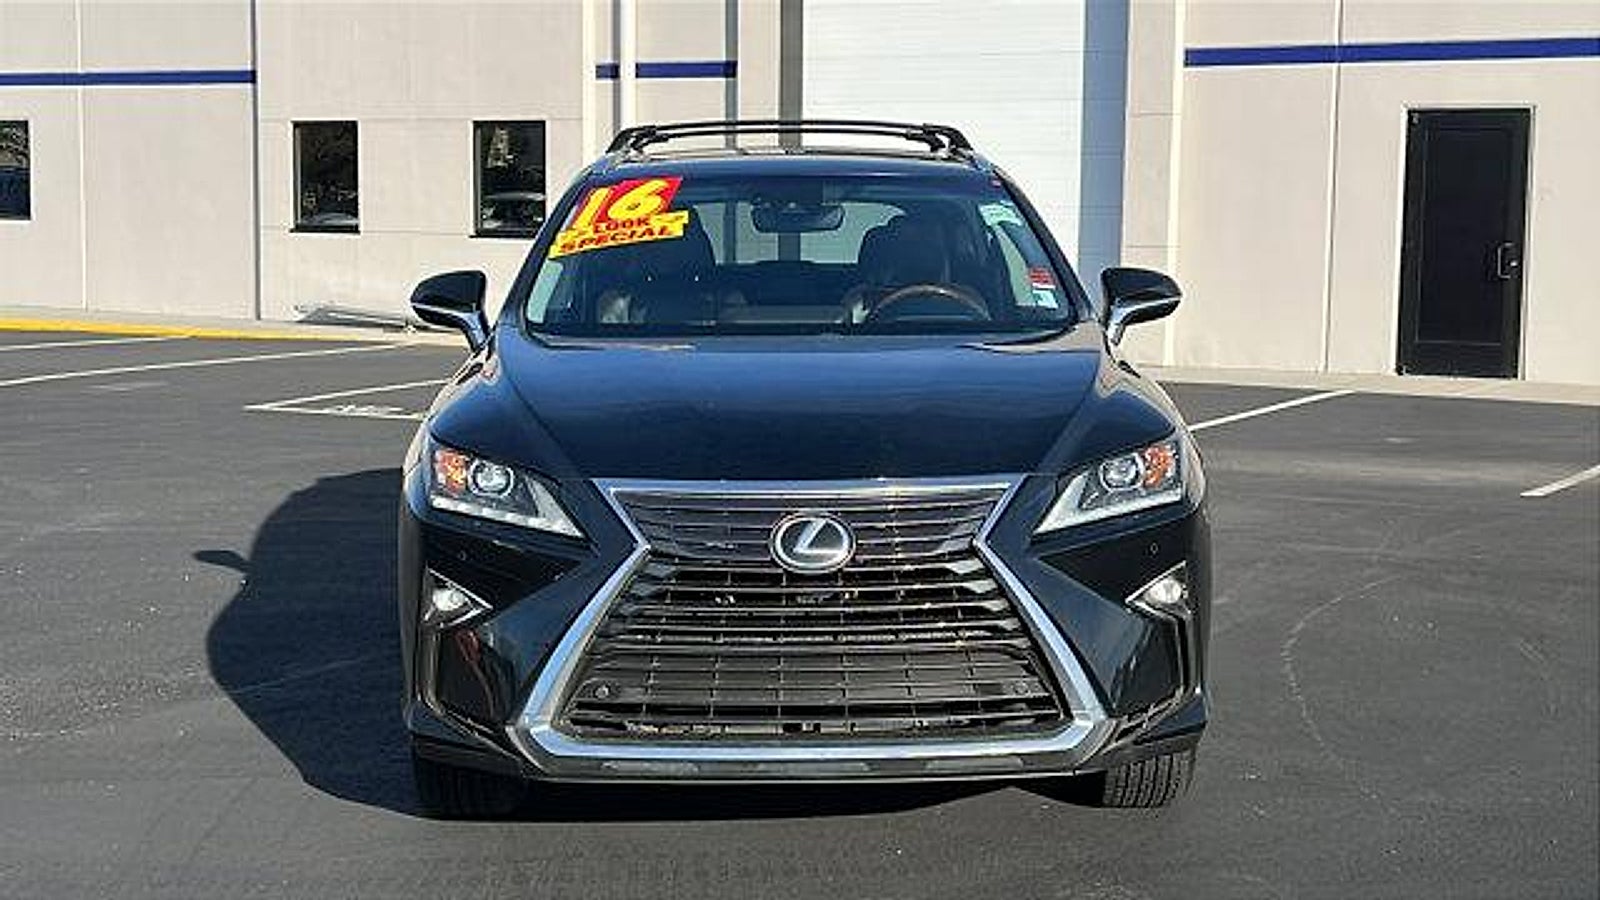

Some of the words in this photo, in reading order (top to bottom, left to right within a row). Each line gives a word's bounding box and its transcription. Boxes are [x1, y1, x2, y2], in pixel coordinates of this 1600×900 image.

[573, 179, 669, 230] 16
[560, 225, 671, 252] SPECIAL
[593, 217, 651, 234] LOOK
